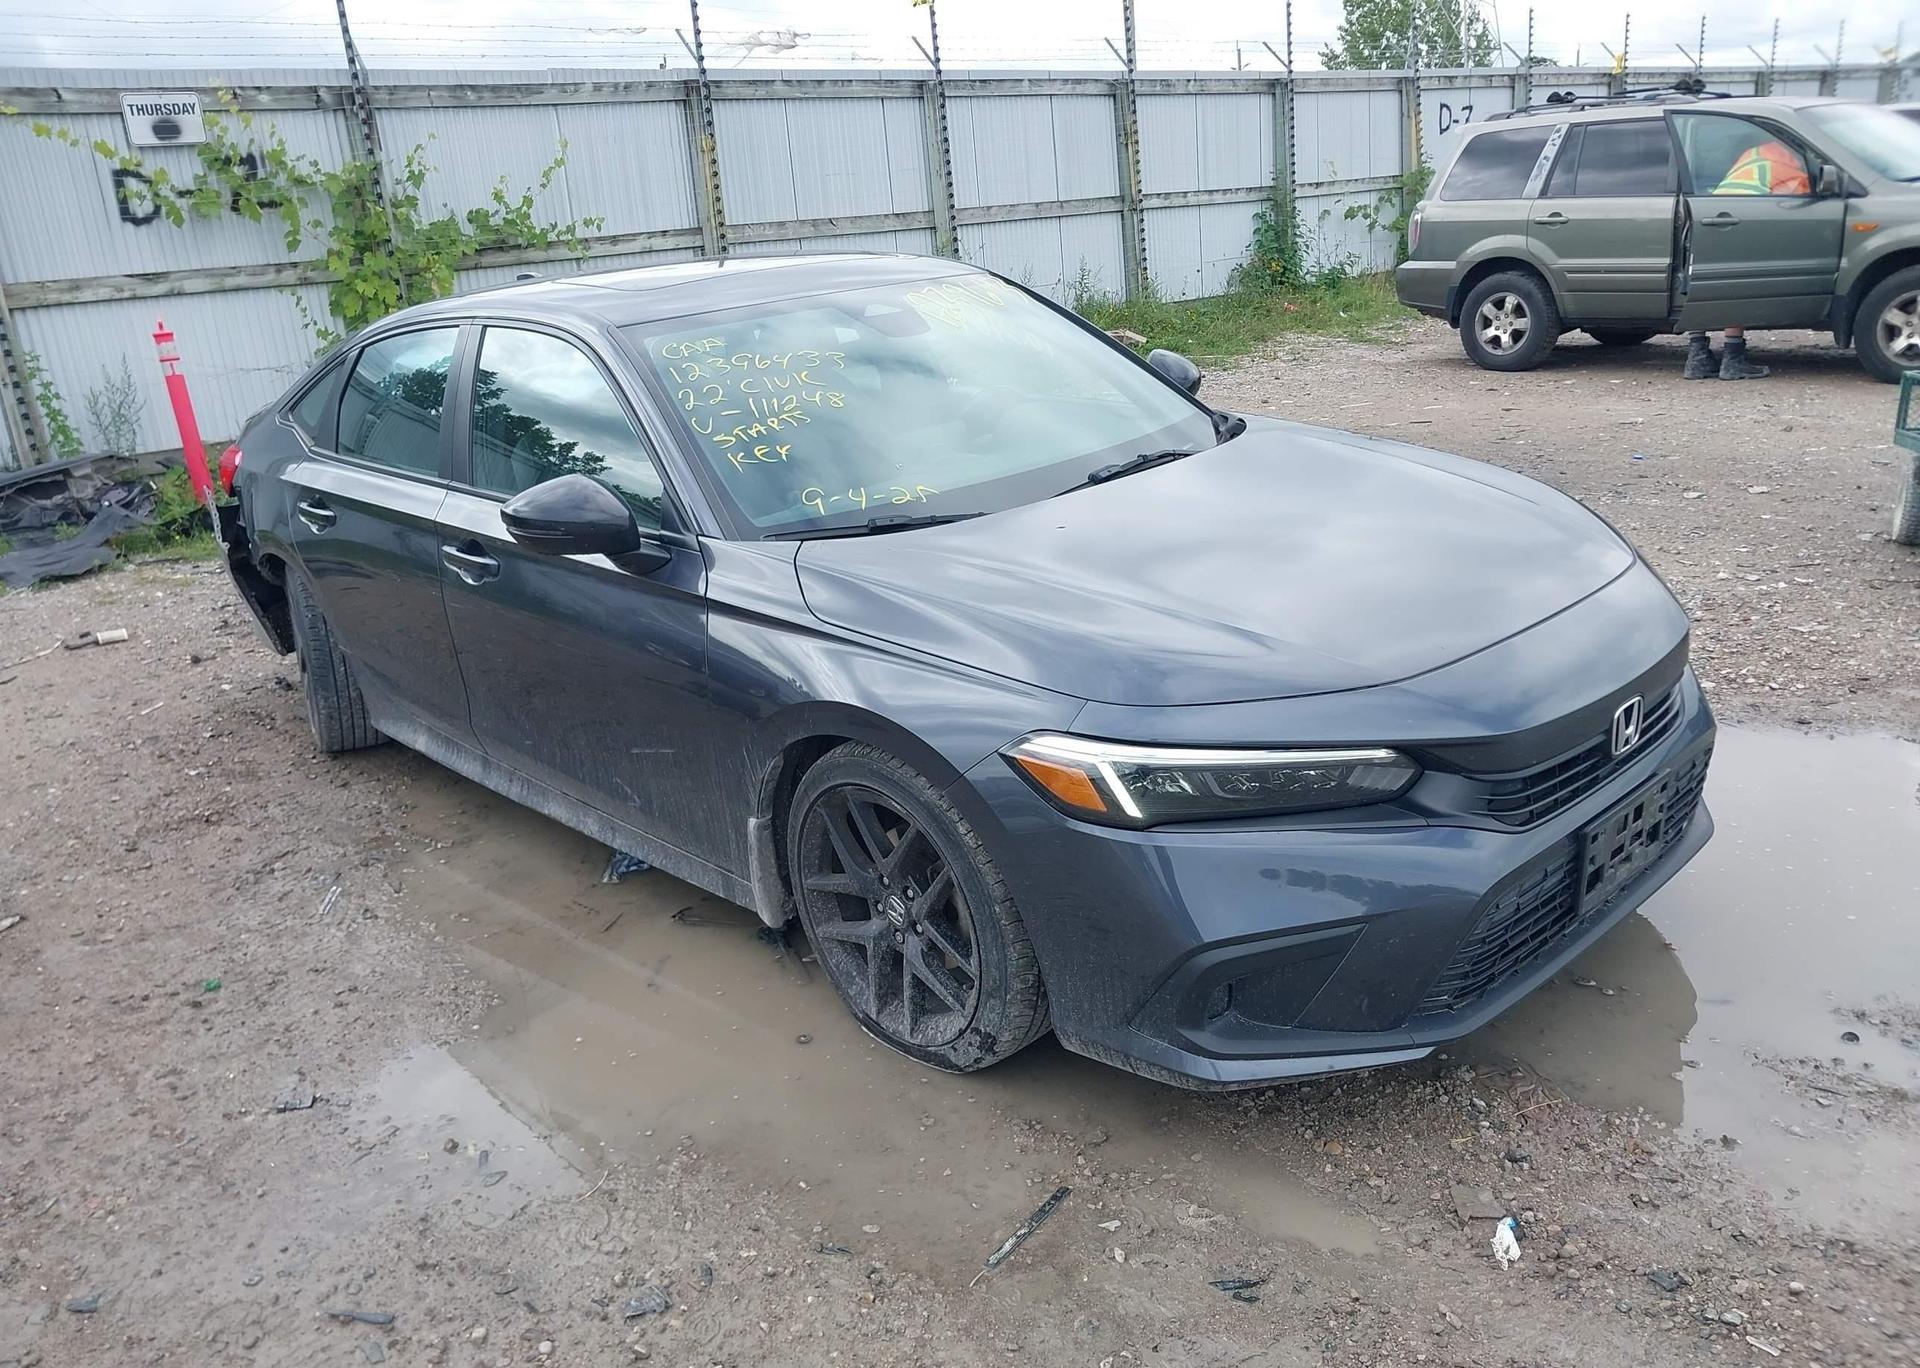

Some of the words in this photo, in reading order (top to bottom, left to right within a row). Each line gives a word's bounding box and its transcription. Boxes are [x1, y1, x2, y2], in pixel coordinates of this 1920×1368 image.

[127, 102, 196, 117] THURSDAY
[1439, 102, 1473, 135] D-7
[662, 338, 727, 359] CAA
[727, 445, 792, 474] KEY
